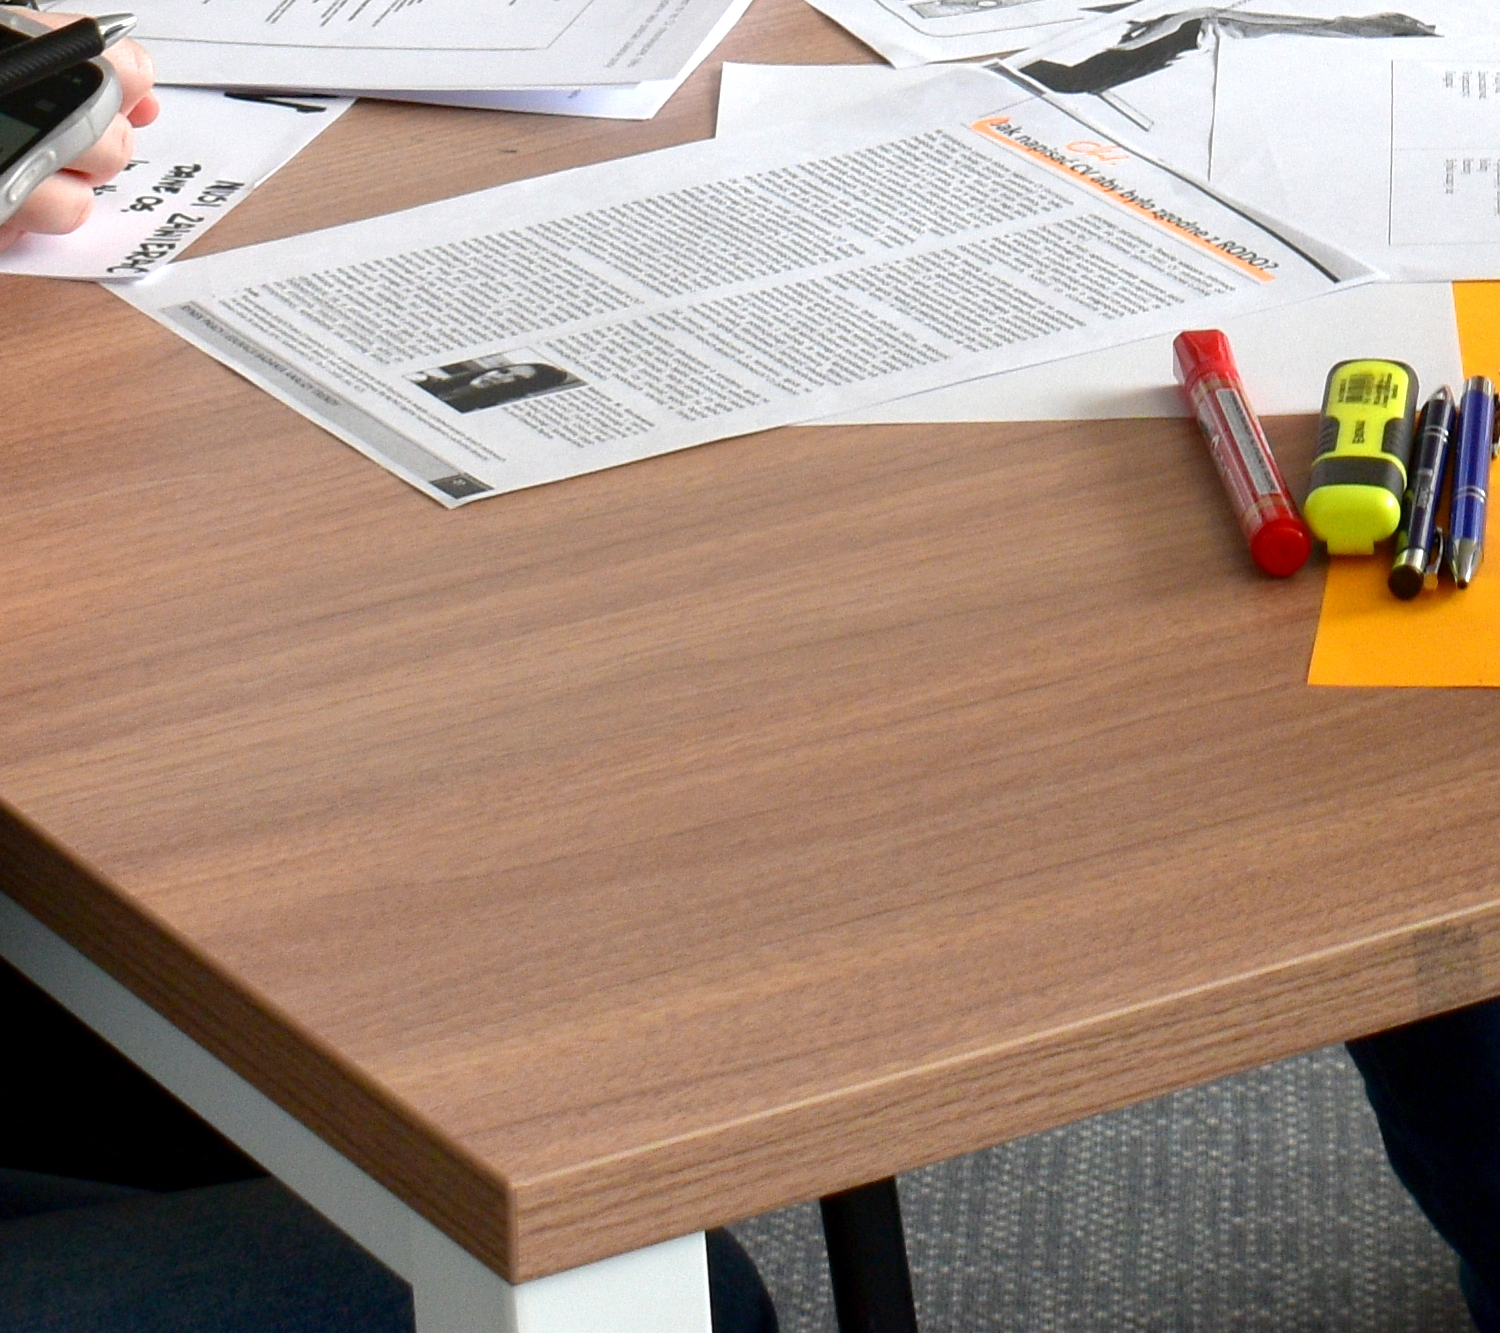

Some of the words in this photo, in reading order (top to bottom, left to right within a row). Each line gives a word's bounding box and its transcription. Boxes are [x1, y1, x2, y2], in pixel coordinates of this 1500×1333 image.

[1070, 161, 1094, 177] CV
[1090, 174, 1123, 193] aby
[1119, 187, 1157, 212] było
[1215, 240, 1280, 272] RODO?
